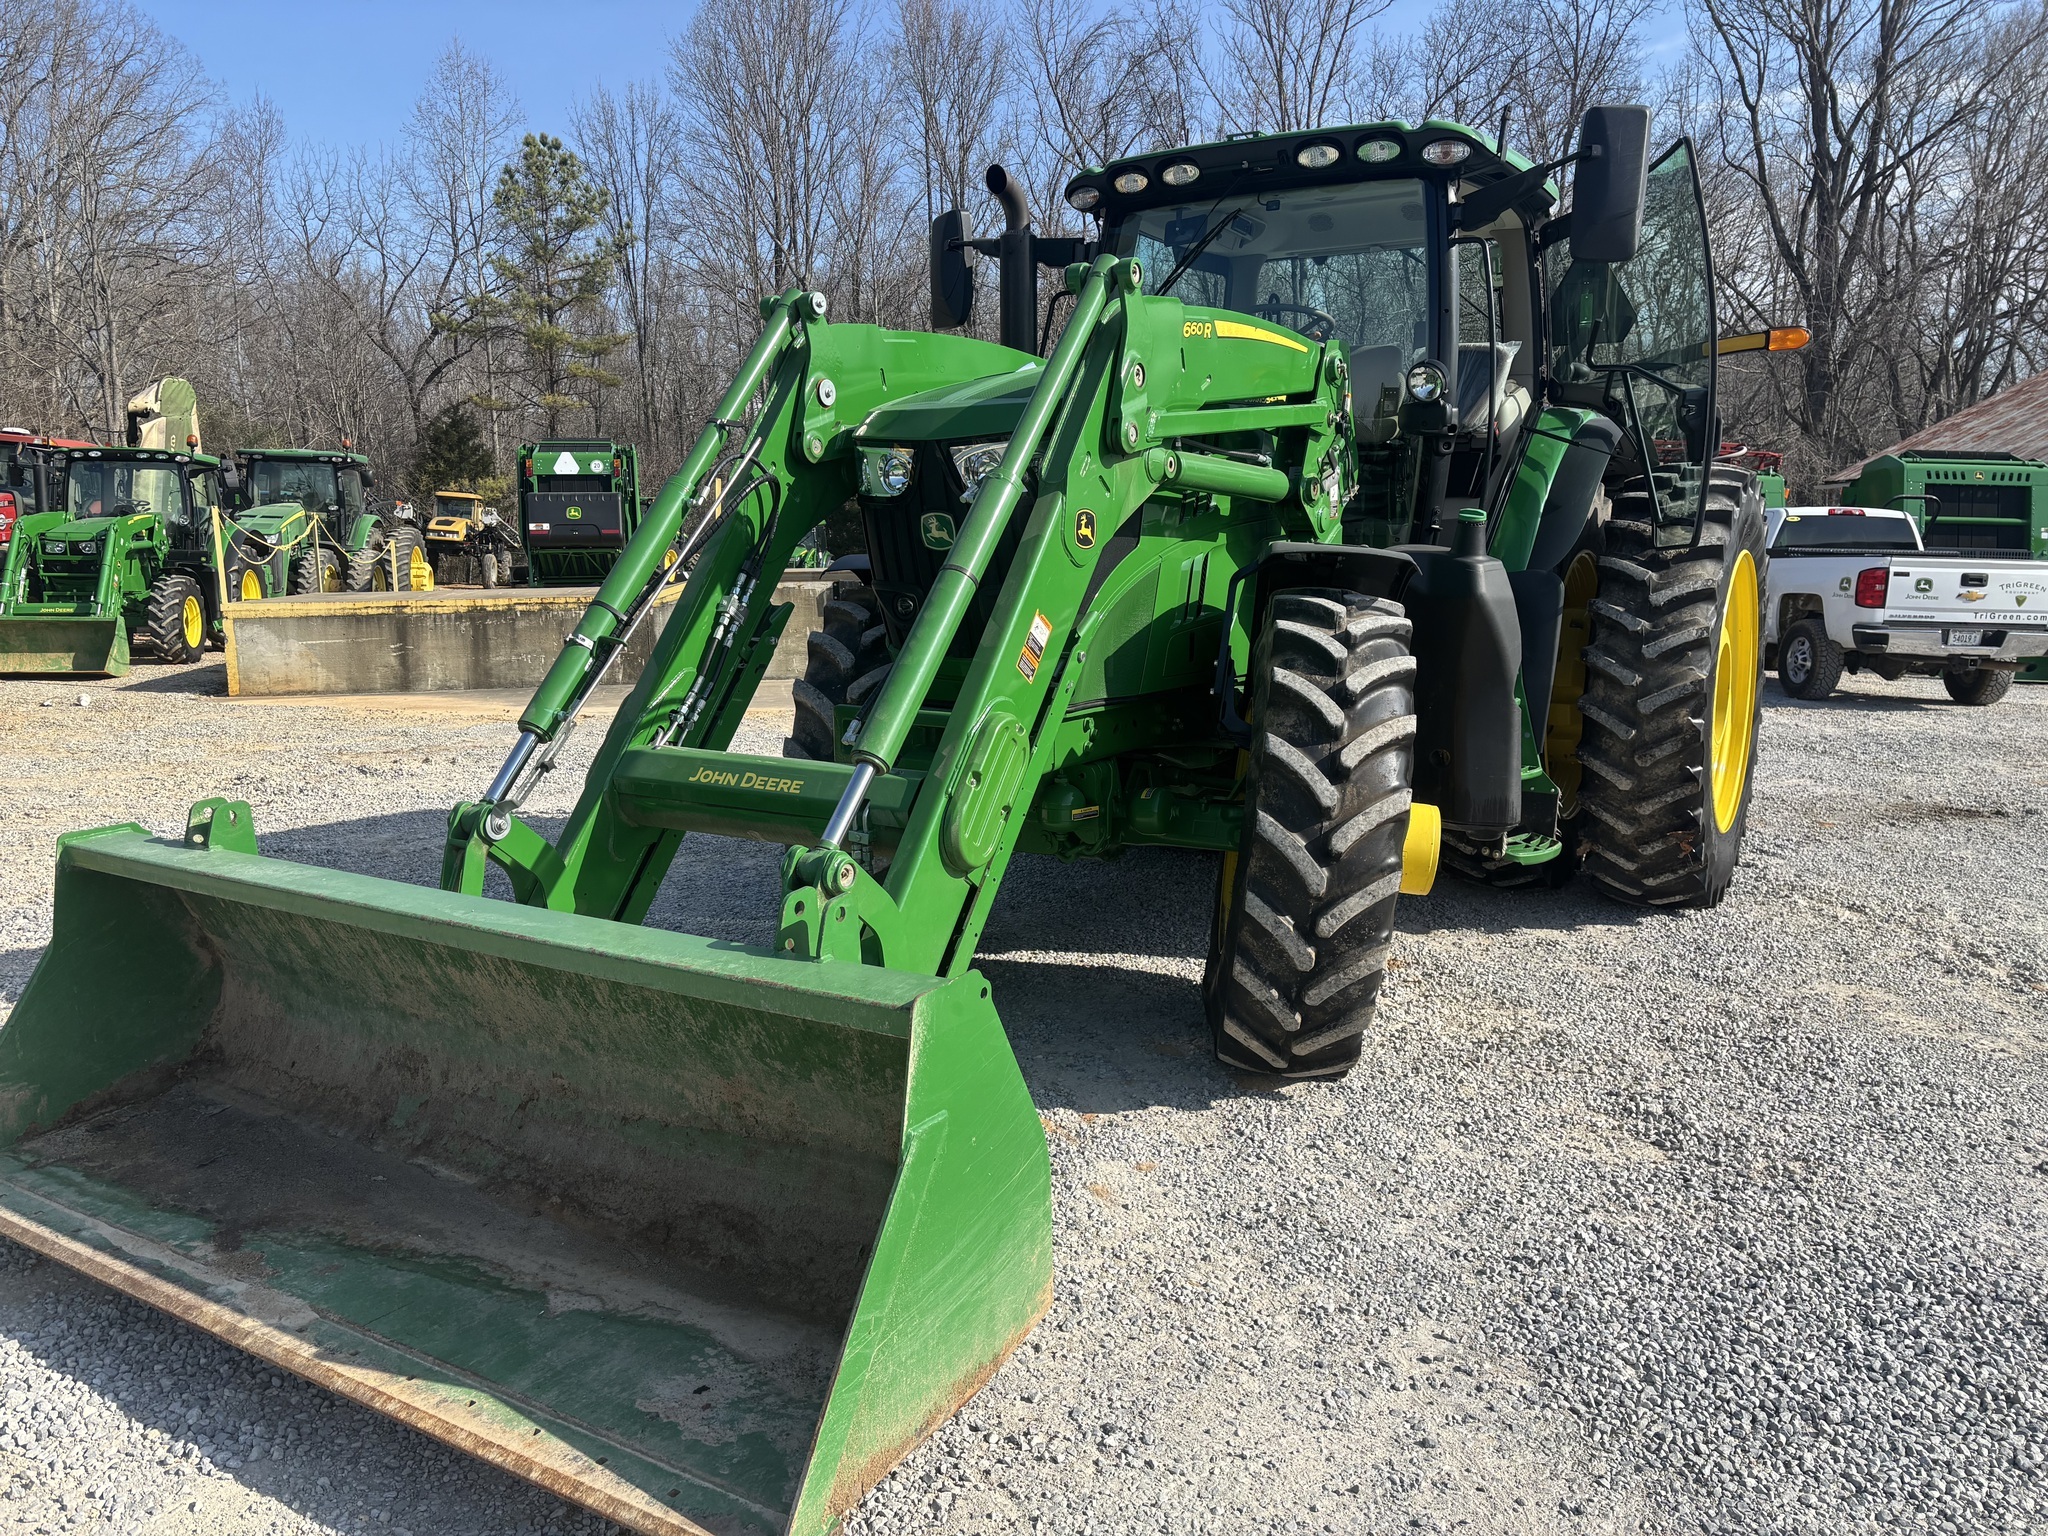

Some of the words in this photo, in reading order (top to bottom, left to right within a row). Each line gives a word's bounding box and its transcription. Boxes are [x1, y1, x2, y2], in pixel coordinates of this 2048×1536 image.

[1999, 581, 2047, 593] TRIGREEN
[1973, 612, 2048, 621] TriGreen.com
[689, 767, 739, 786] JOHN
[740, 772, 805, 794] DEERE
